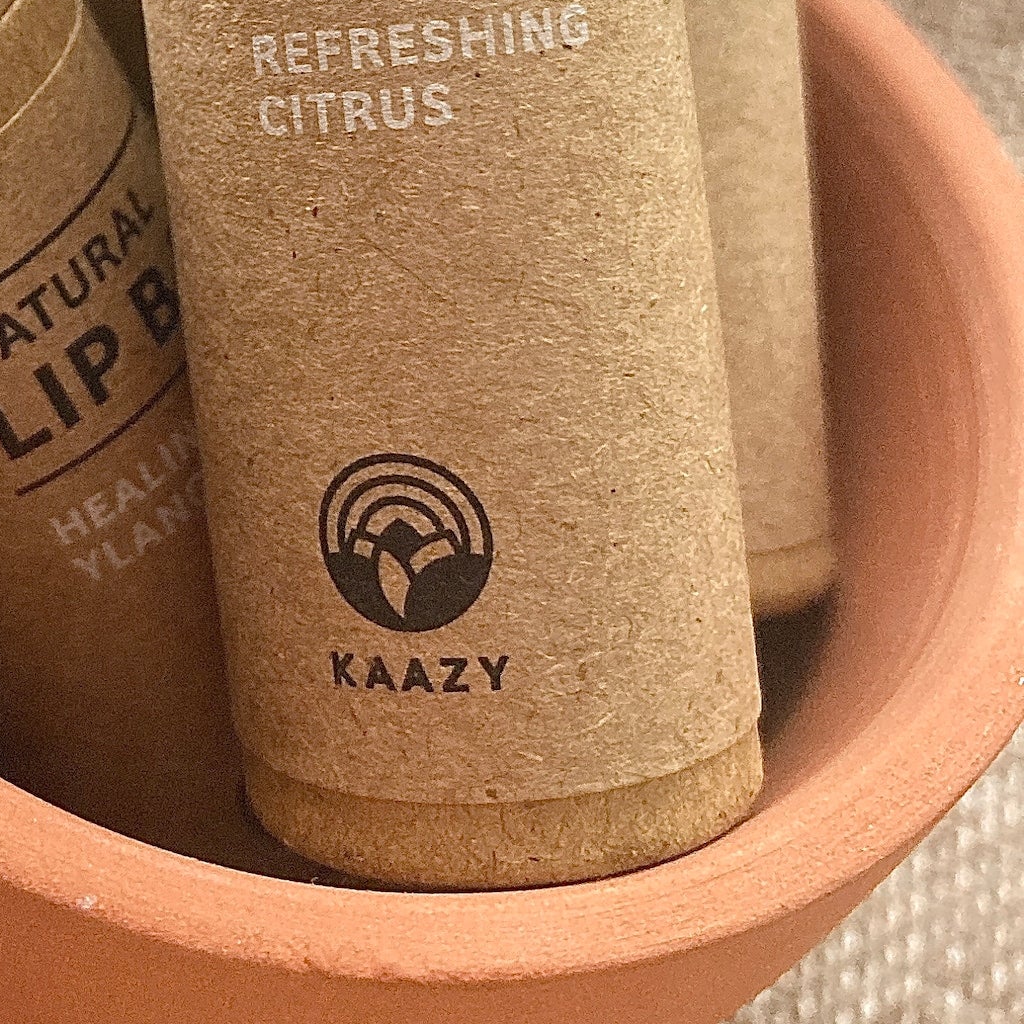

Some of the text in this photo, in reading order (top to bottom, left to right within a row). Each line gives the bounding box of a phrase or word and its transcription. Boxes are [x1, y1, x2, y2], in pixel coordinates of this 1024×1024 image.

[252, 2, 592, 78] REFRESHING
[258, 82, 456, 137] CITRUS
[330, 650, 510, 693] KAAZY
